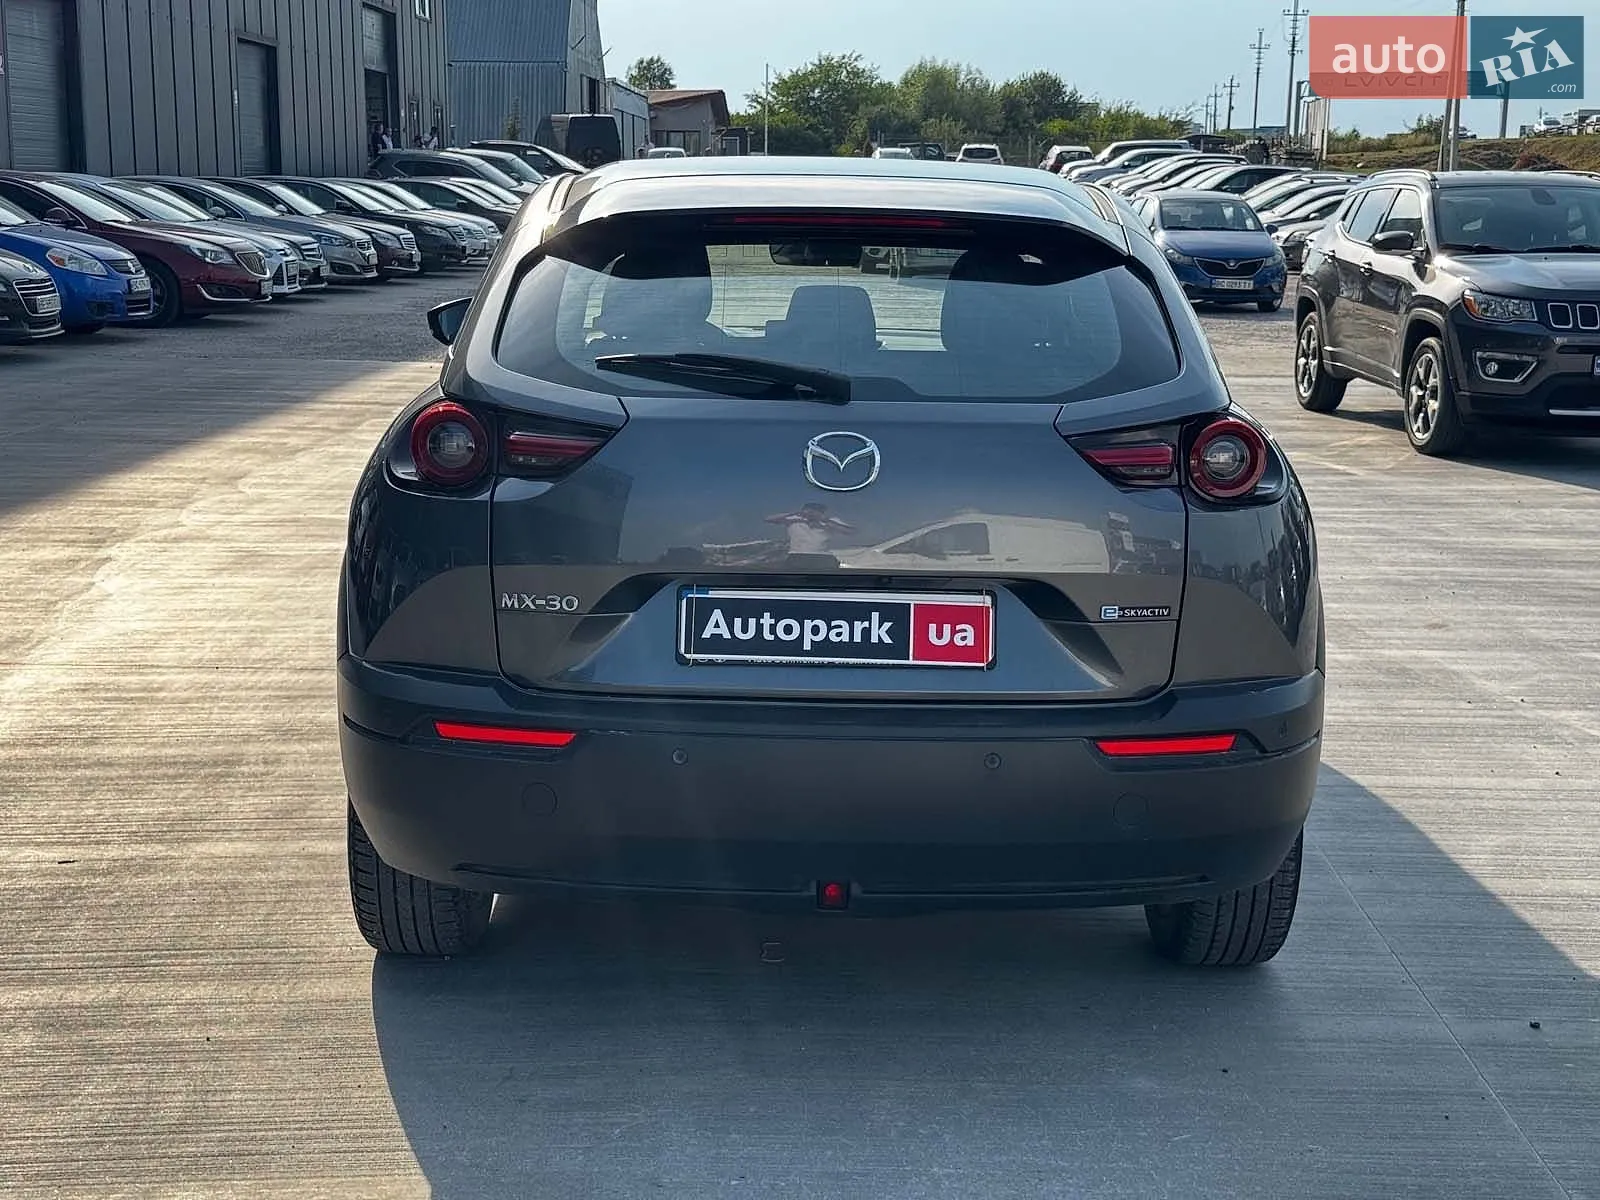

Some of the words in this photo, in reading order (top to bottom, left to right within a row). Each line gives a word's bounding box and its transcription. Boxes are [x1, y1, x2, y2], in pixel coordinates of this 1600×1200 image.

[501, 592, 579, 611] MX-30
[701, 608, 894, 650] Autopark
[928, 622, 975, 646] ua
